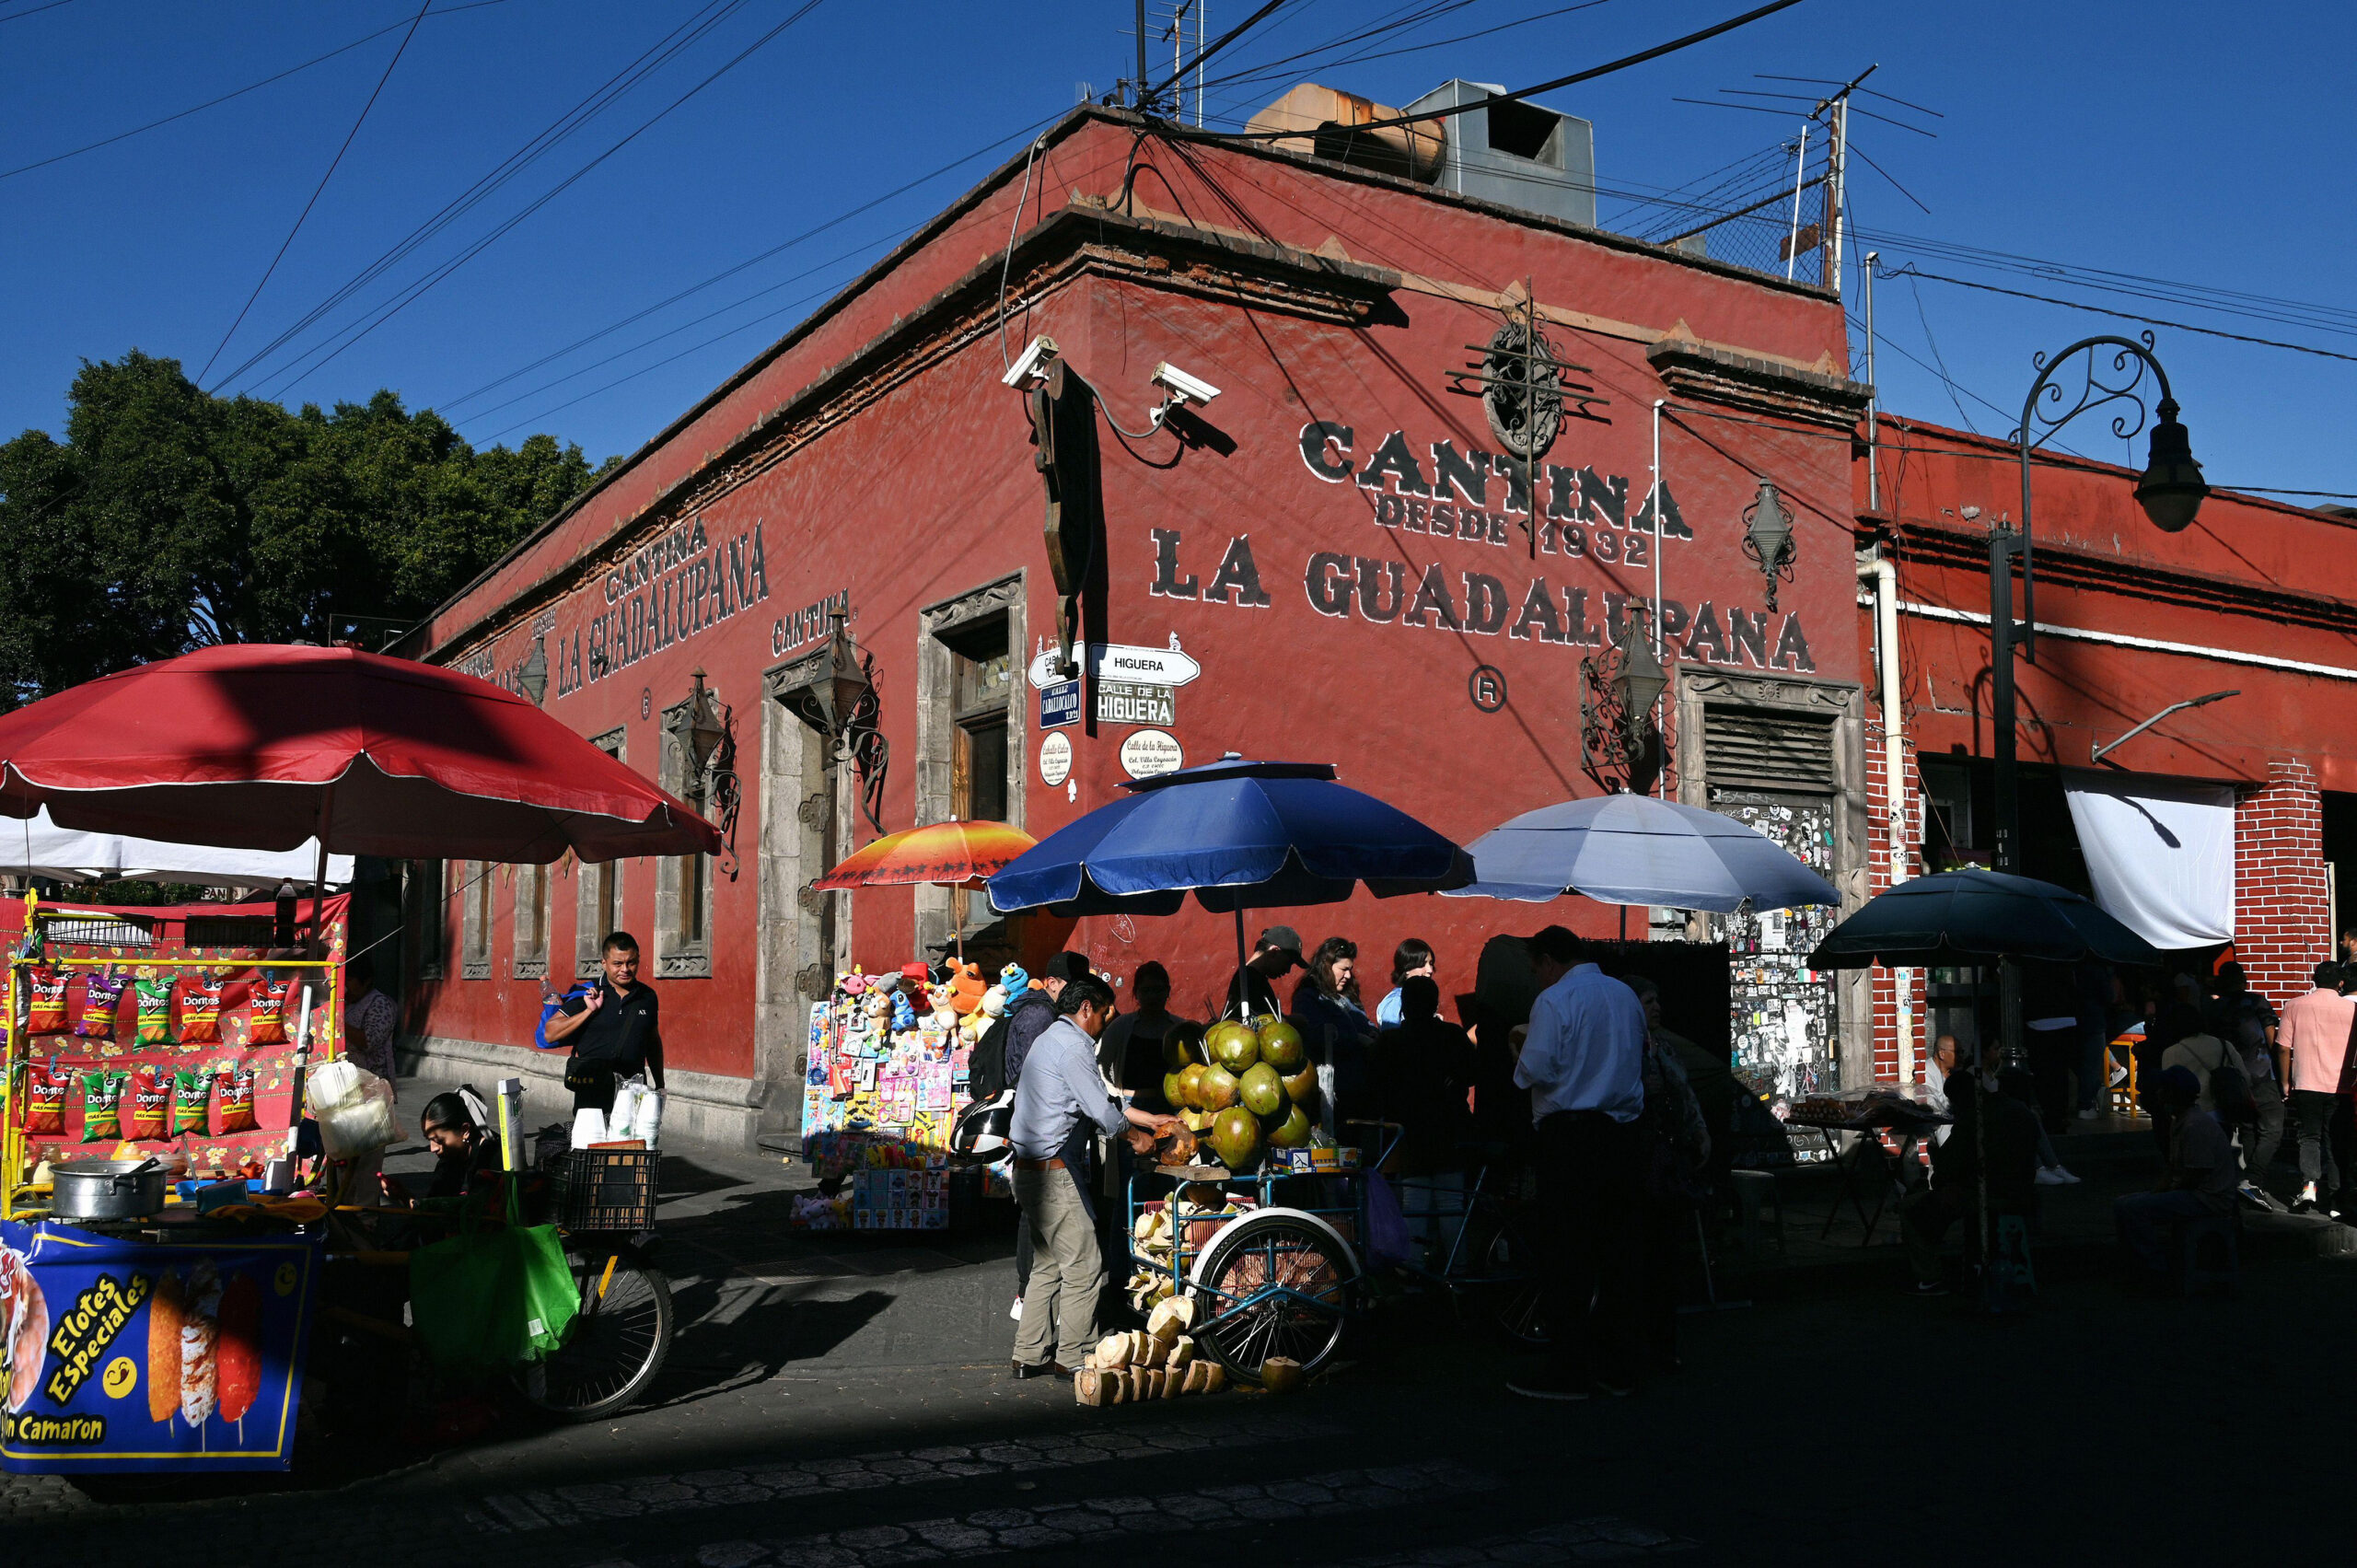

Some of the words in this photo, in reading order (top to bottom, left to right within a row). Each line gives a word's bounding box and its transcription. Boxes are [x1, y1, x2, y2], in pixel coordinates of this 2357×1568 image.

[1298, 420, 1693, 541] CANTINA
[1375, 493, 1509, 547] DESDE
[1538, 522, 1648, 568] 1932
[1150, 528, 1271, 608] LA
[558, 624, 582, 700] LA
[588, 517, 770, 681] GUADALUPANA
[1114, 657, 1164, 671] HIGUERA
[1098, 684, 1132, 696] CALLE
[1138, 687, 1153, 697] DE
[1157, 690, 1171, 700] LA
[1097, 695, 1171, 723] HIGUERA
[1127, 740, 1141, 751] Calle
[1142, 740, 1148, 751] de
[1149, 740, 1155, 751] la
[1156, 740, 1178, 755] Higuera
[33, 983, 64, 994] Dorito
[87, 990, 117, 1001] Dorito
[183, 996, 220, 1005] Doritos
[33, 1085, 64, 1095] Dorito
[178, 1089, 208, 1099] Dorito
[87, 1094, 118, 1104] Dorito
[52, 1278, 116, 1357] Elotes
[49, 1274, 147, 1402] Especiales
[18, 1416, 103, 1441] Camaron
